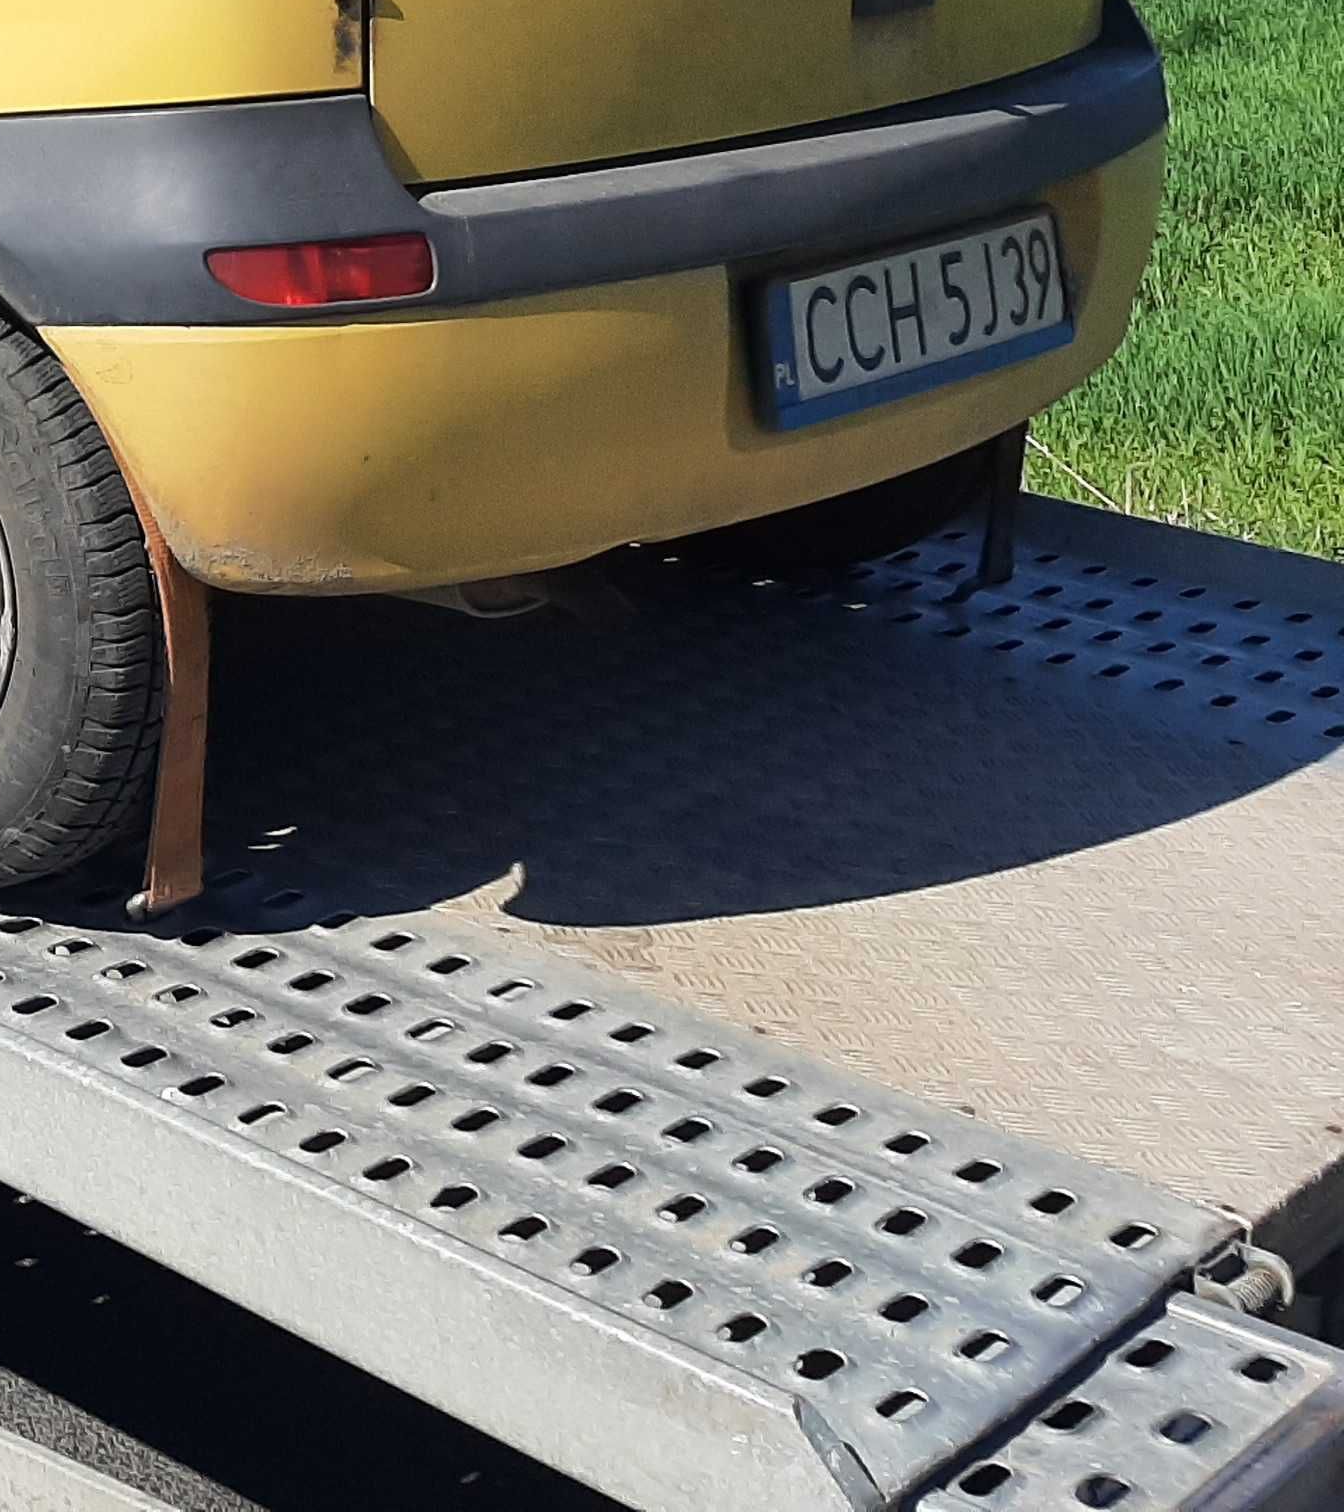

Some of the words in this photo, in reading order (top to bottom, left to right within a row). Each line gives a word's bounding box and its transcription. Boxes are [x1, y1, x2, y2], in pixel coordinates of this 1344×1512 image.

[805, 261, 928, 384] CCH
[939, 228, 1051, 346] 5J39
[774, 362, 795, 389] PL
